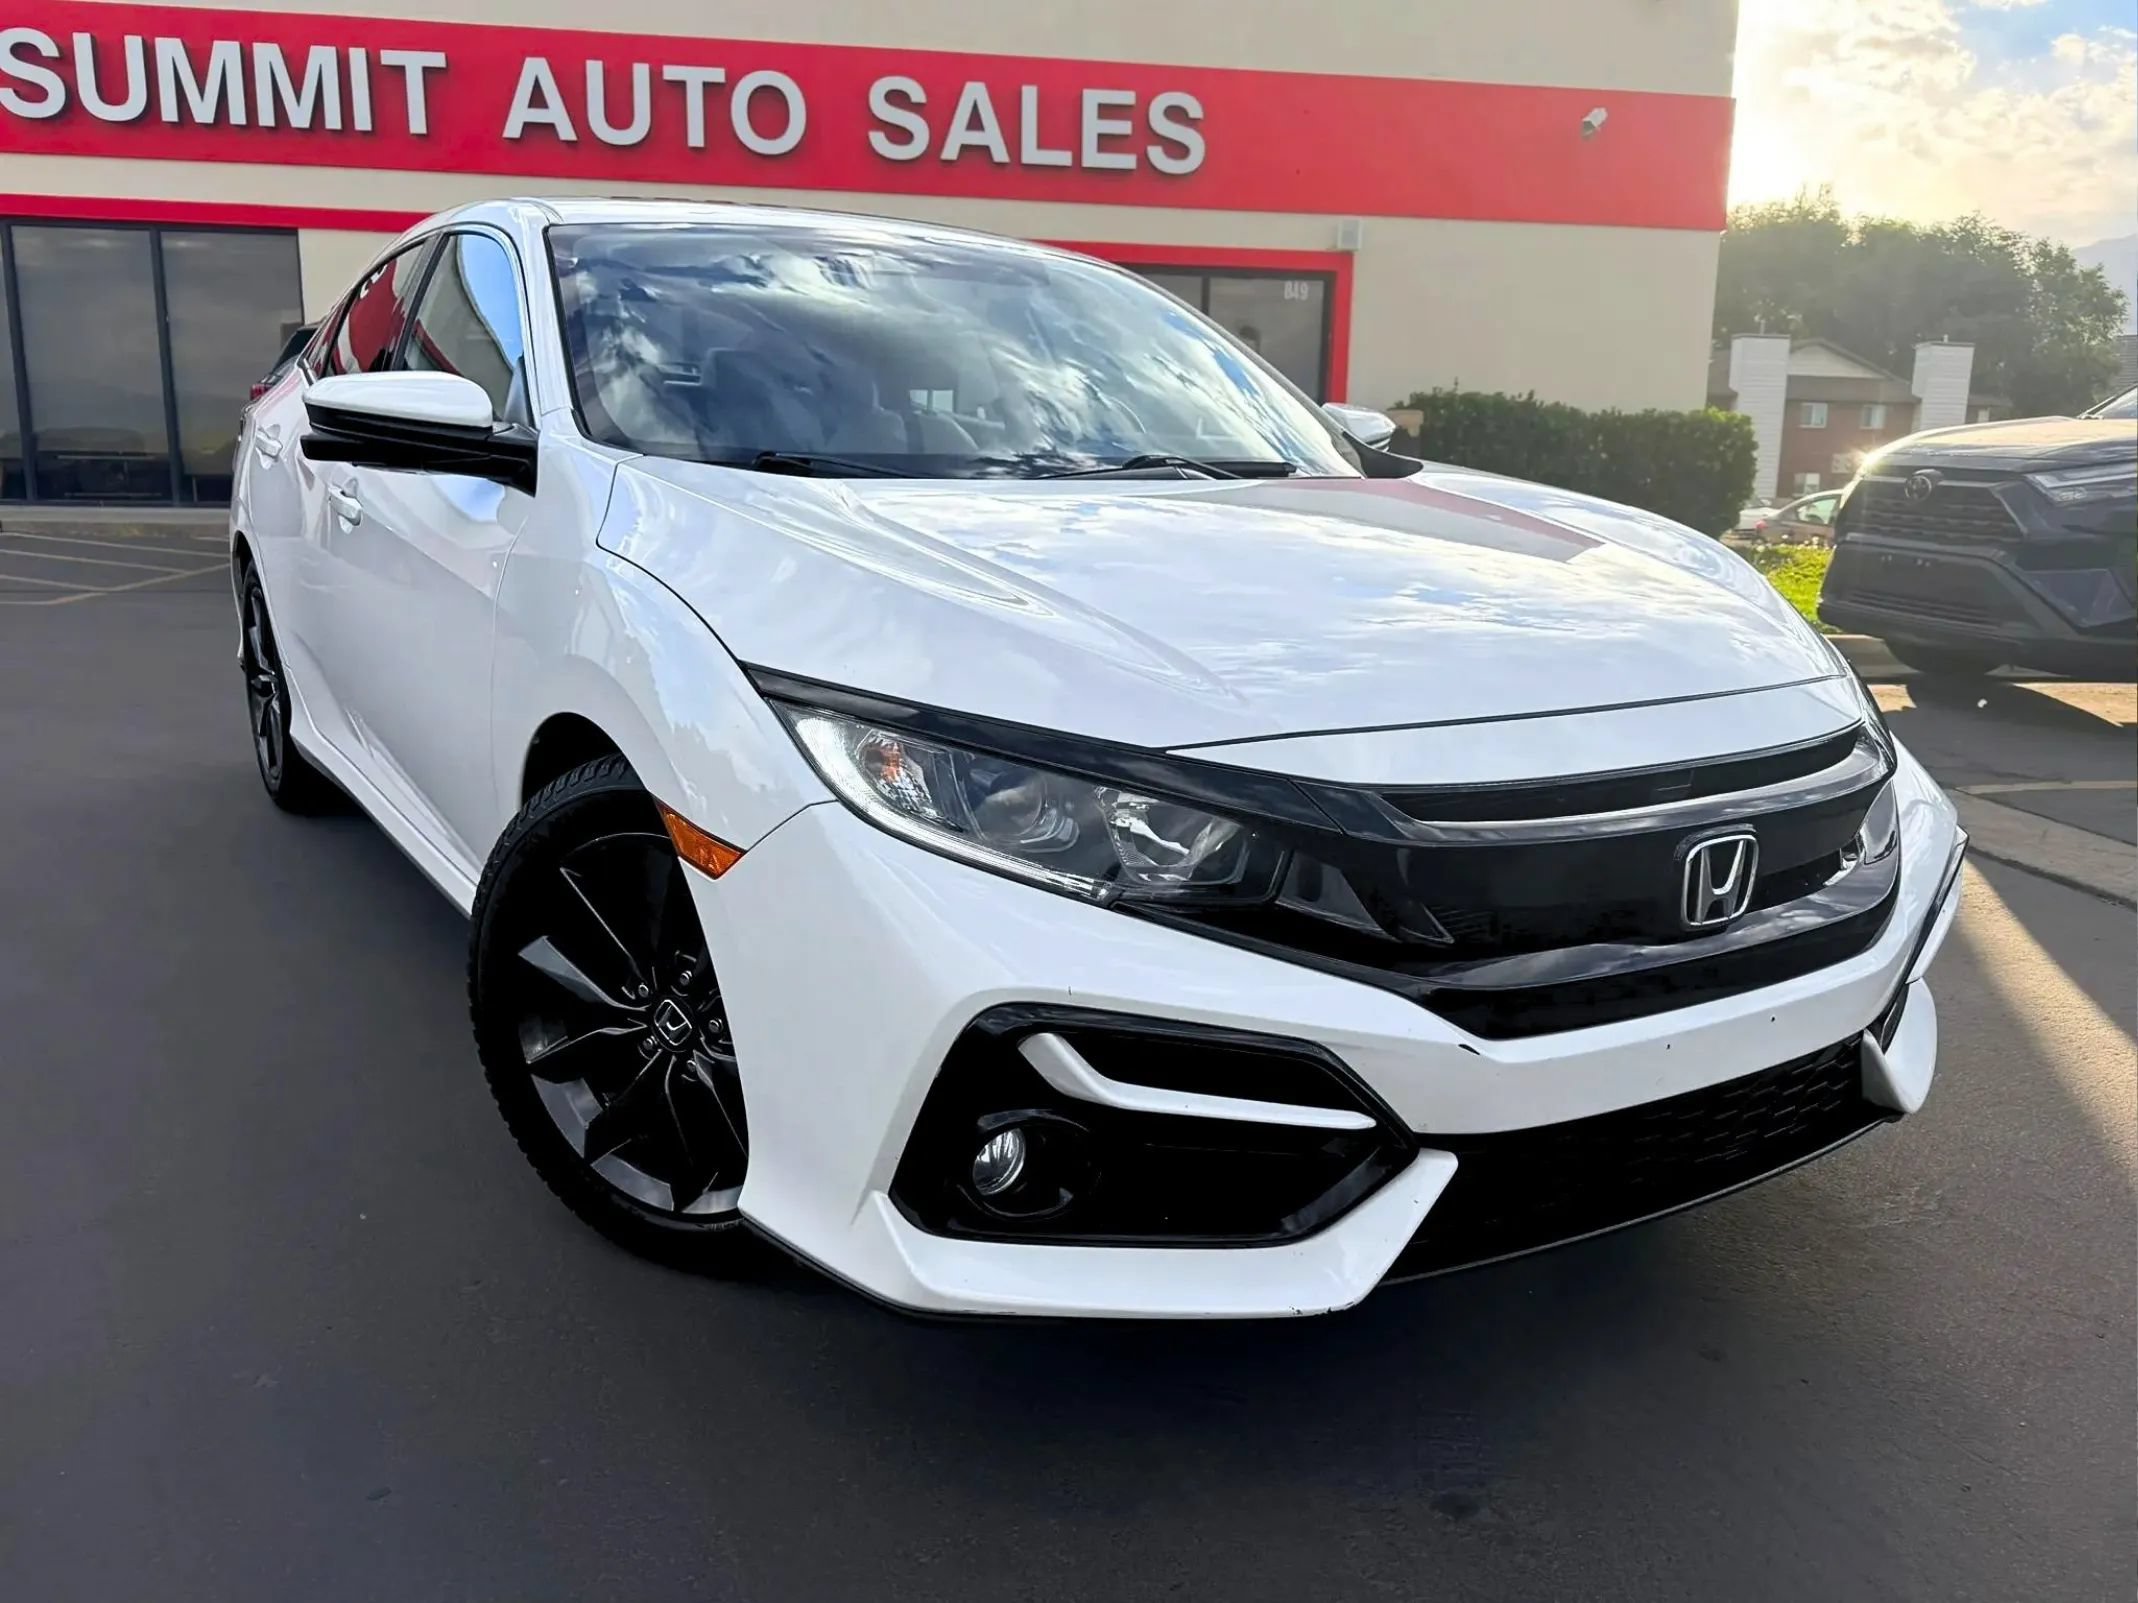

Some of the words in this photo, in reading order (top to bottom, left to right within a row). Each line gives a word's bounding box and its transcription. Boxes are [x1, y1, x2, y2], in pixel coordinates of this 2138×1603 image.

[0, 27, 447, 135] SUMMIT
[502, 56, 807, 156] AUTO
[867, 75, 1206, 175] SALES
